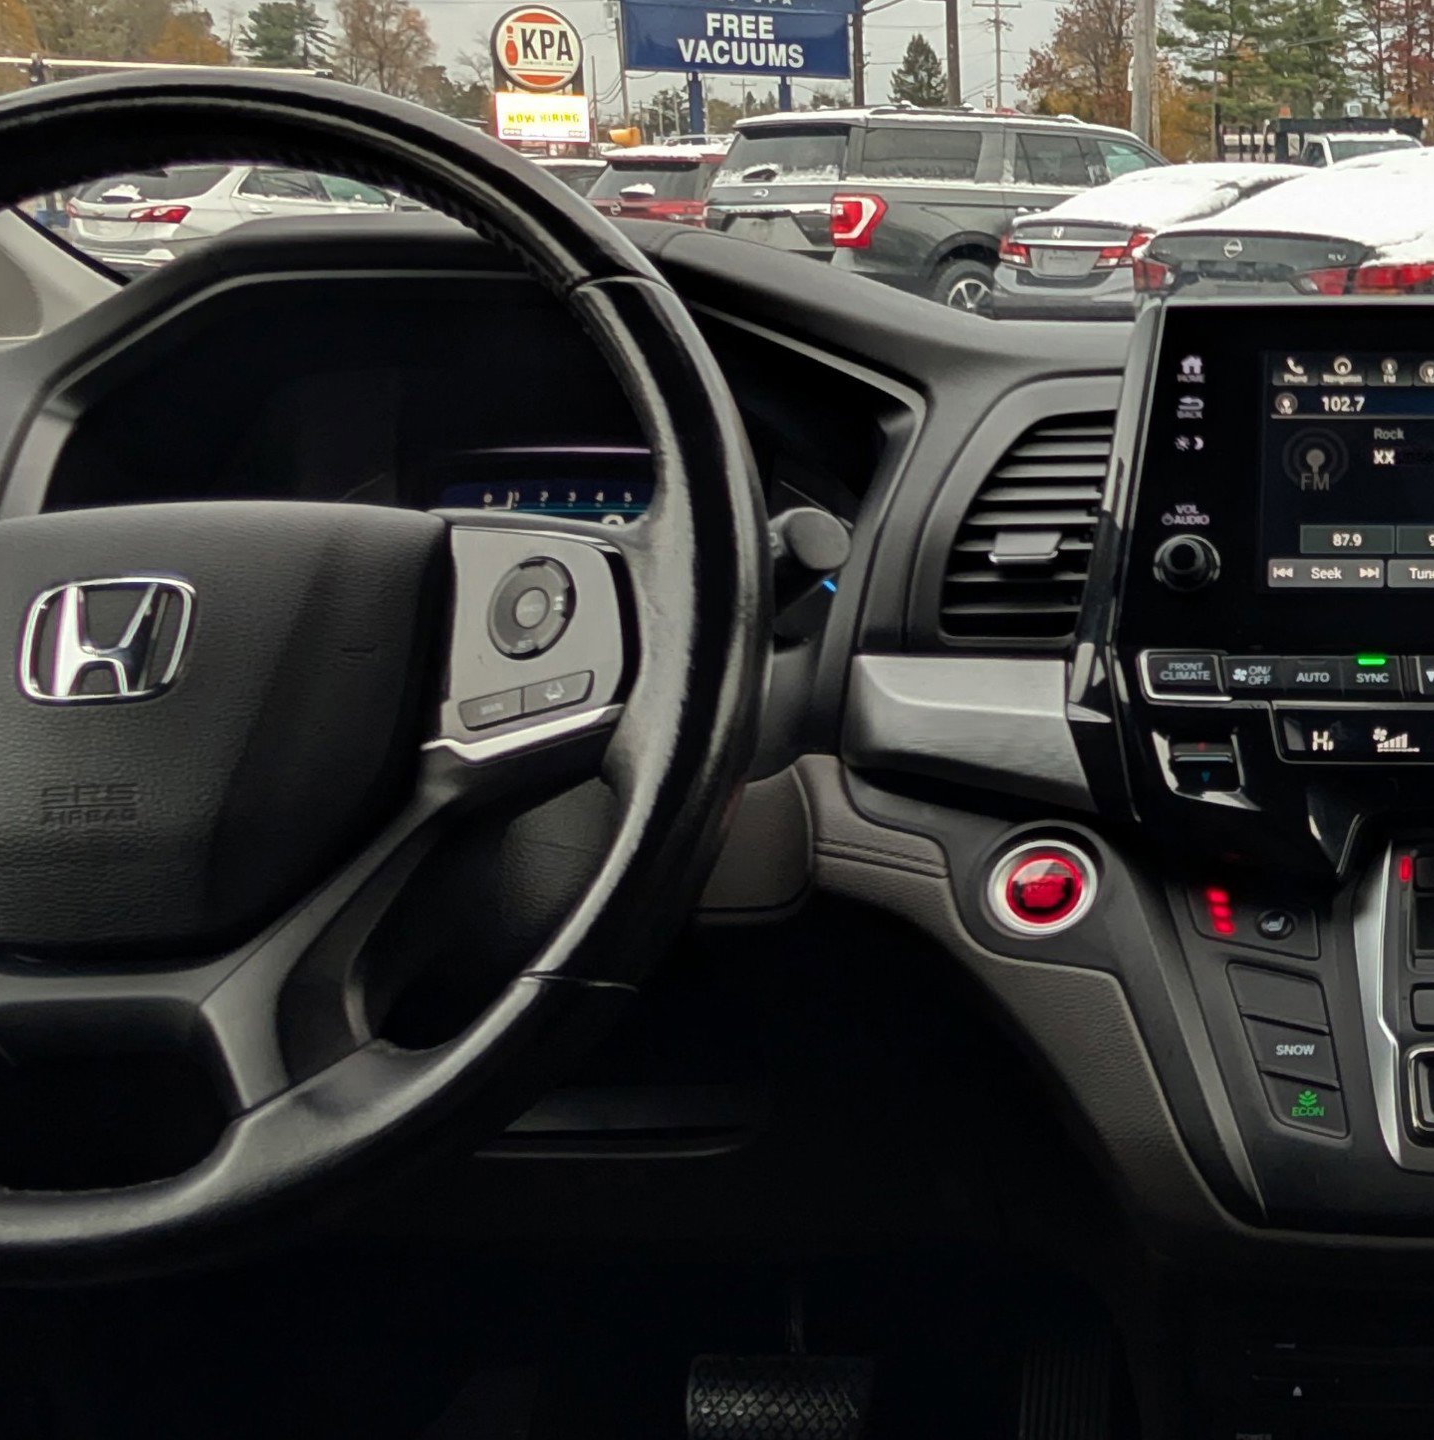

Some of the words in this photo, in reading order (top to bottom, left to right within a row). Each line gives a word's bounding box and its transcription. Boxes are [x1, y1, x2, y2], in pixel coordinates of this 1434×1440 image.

[706, 12, 775, 40] FREE
[520, 28, 574, 62] KPA
[677, 38, 805, 69] VACUUMS
[1321, 396, 1365, 412] 102.7
[1373, 428, 1405, 442] Rock
[1300, 472, 1331, 492] FM
[1175, 504, 1200, 515] VOL
[1173, 514, 1210, 526] AUDIO
[1331, 533, 1363, 547] 87.9
[1310, 566, 1343, 581] Seek
[1166, 661, 1205, 674] FRONT
[1159, 668, 1212, 682] CLIMATE
[1247, 674, 1272, 686] OFF
[1296, 671, 1331, 685] AUTO
[1355, 671, 1390, 685] SYNC
[1275, 1043, 1316, 1057] SNOW
[1291, 1105, 1325, 1118] ECON
